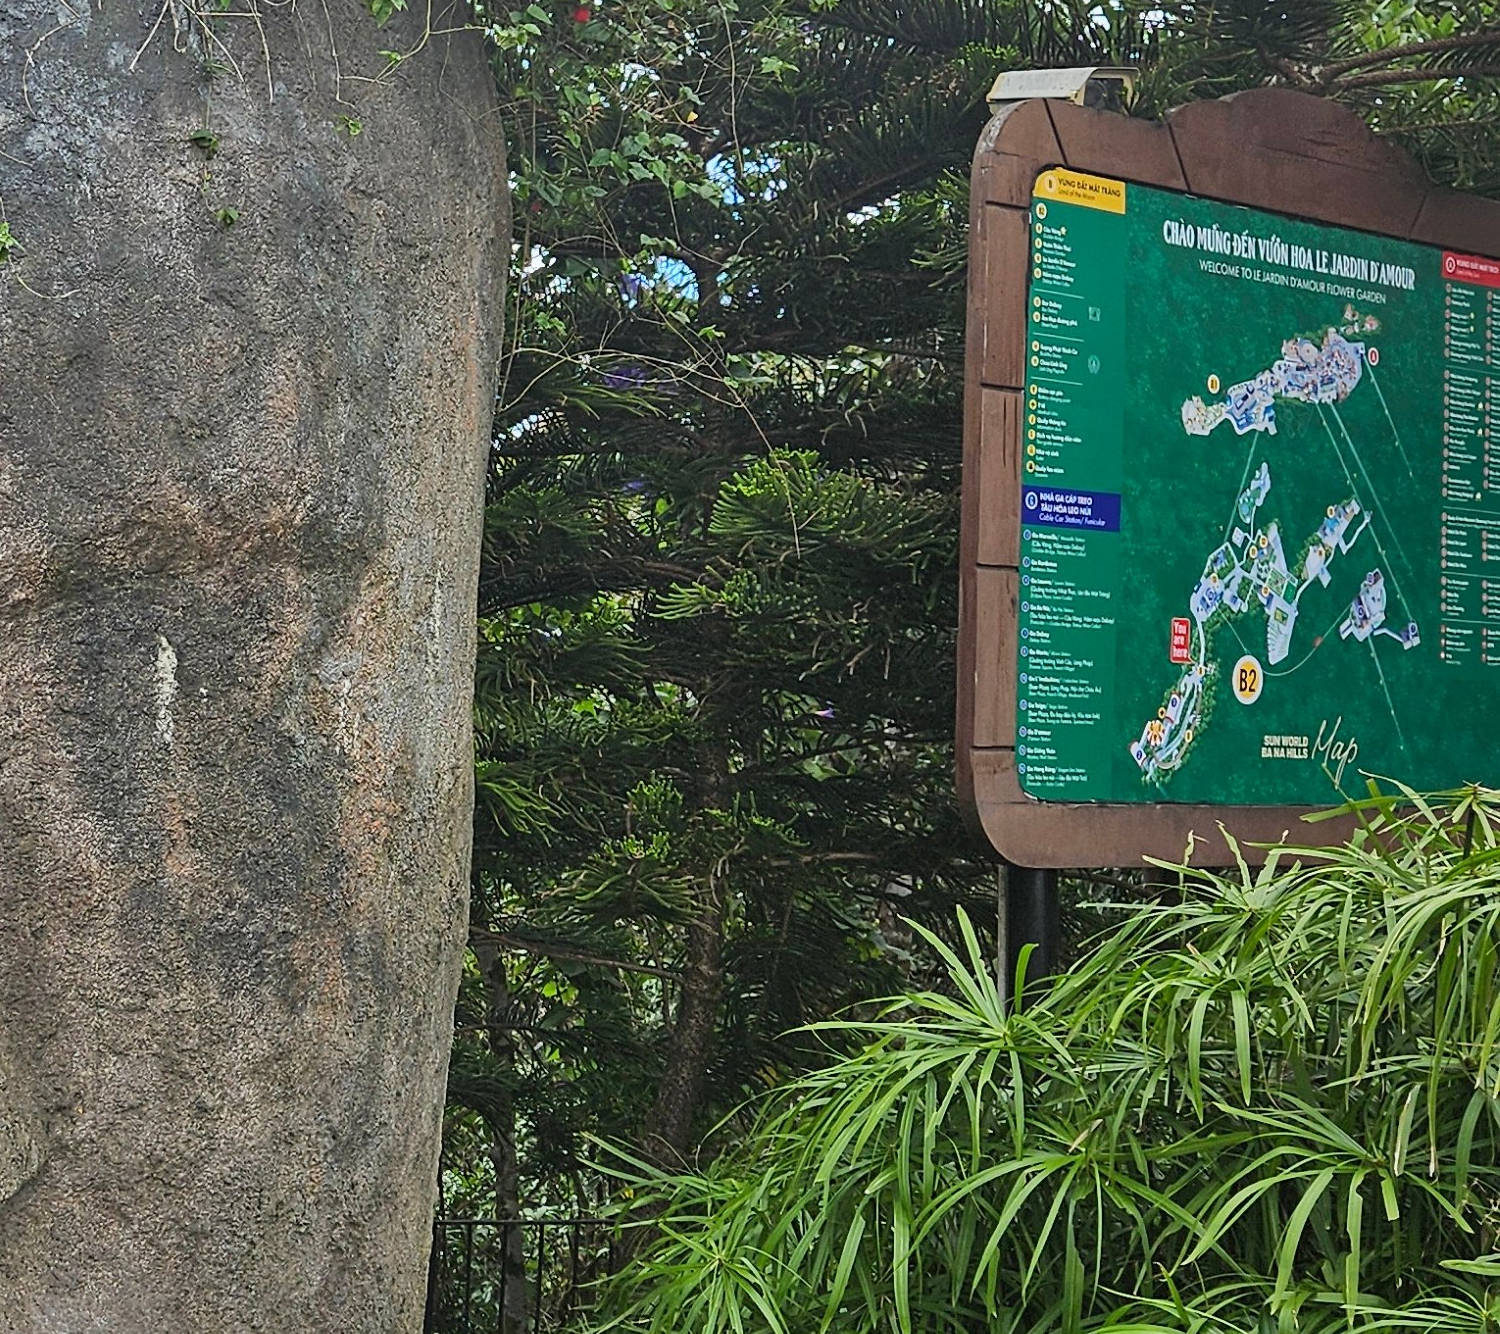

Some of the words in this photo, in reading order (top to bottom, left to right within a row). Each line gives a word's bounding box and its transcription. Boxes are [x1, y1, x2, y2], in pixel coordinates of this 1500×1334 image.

[1163, 218, 1196, 249] CHÀO
[1197, 223, 1232, 256] MỪNG
[1232, 229, 1257, 260] ĐẾN
[1257, 234, 1289, 267] VƯỜN
[1290, 244, 1314, 271] HOA
[1315, 249, 1329, 273] LE
[1329, 253, 1369, 282] JARDIN
[1369, 259, 1416, 291] D'AMOUR
[1198, 259, 1240, 278] WELCOME
[1240, 266, 1253, 280] TO
[1253, 269, 1261, 282] LE
[1261, 270, 1290, 286] JARDIN
[1290, 276, 1326, 293] D'AMOUR
[1326, 282, 1355, 300] FLOWER
[1355, 288, 1387, 305] GARDEN
[1054, 494, 1065, 503] GA
[1039, 512, 1054, 522] Cable
[1054, 514, 1065, 523] Car
[1173, 621, 1187, 635] You
[1173, 635, 1185, 645] are
[1172, 645, 1188, 658] here
[1239, 668, 1257, 693] B2
[1263, 735, 1282, 747] SUN
[1282, 735, 1309, 747] WORLD
[1261, 747, 1273, 758] BA
[1273, 747, 1285, 759] NA
[1286, 747, 1309, 759] HILLS
[1311, 715, 1358, 790] Map
